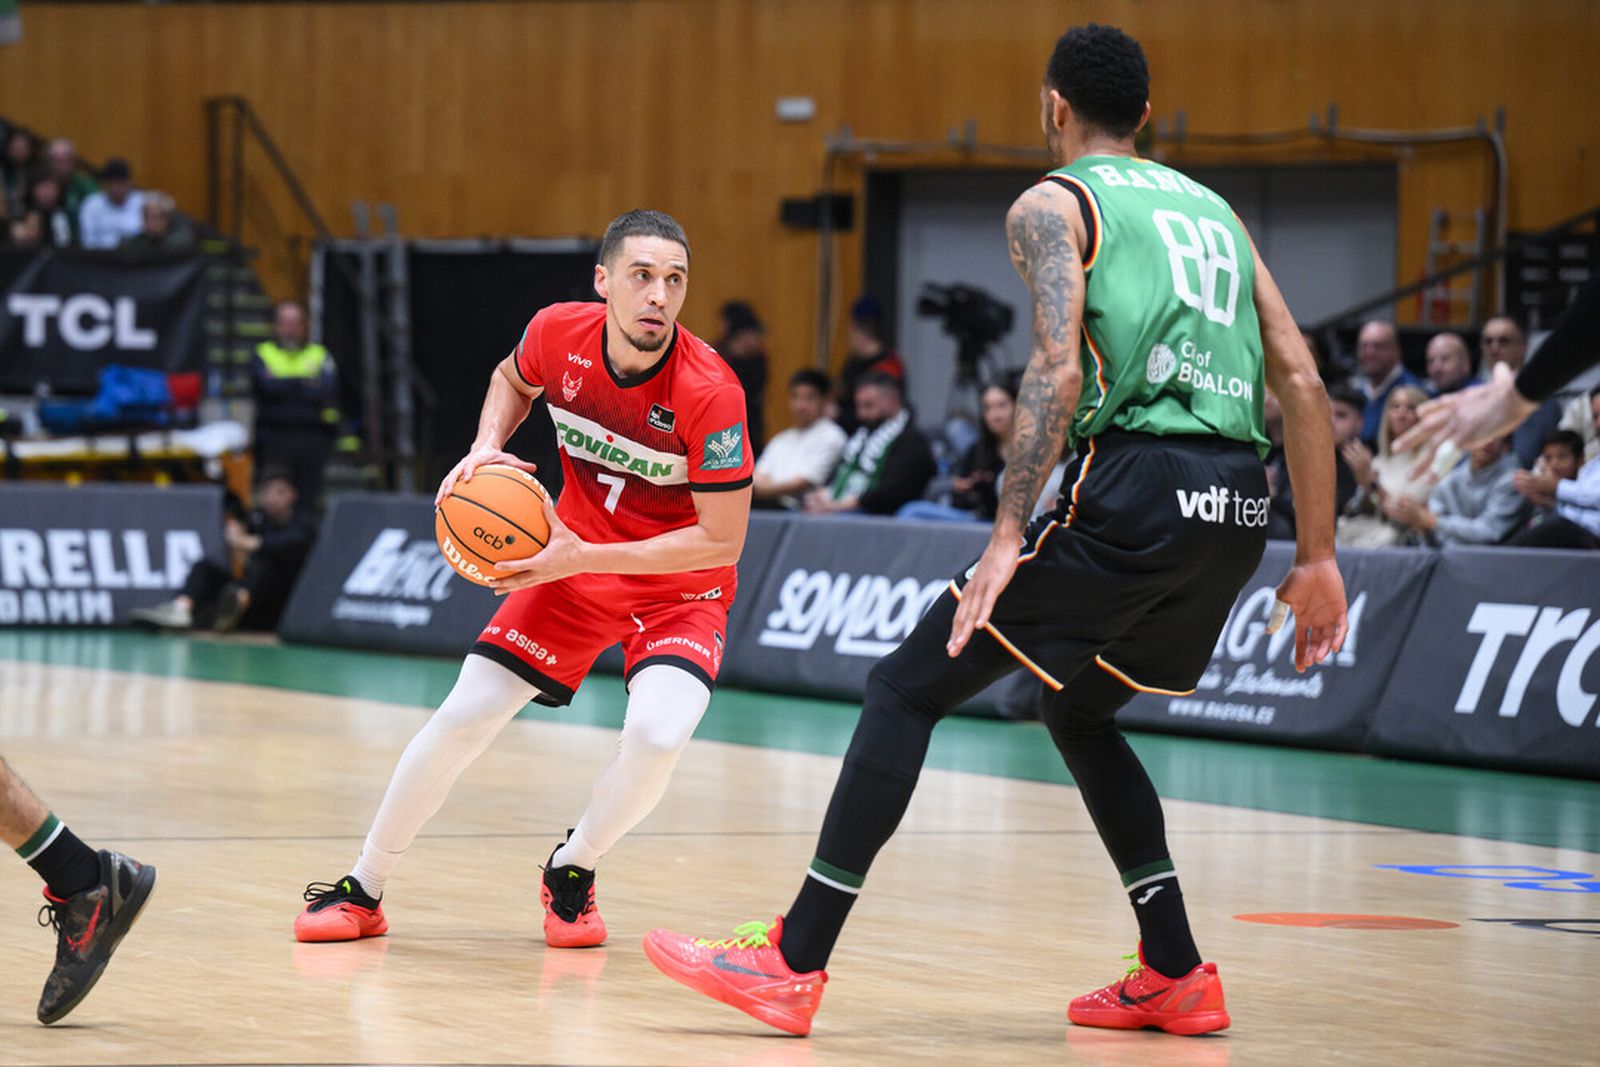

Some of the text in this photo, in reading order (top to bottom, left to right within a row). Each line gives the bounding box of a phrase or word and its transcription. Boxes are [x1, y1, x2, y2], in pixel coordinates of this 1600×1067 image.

[1152, 208, 1240, 327] 88
[8, 293, 157, 351] TCL
[567, 352, 593, 369] vive
[1197, 351, 1212, 368] of
[1177, 362, 1253, 402] BDALON
[597, 473, 626, 515] 7
[1176, 485, 1229, 523] vdf
[473, 526, 504, 550] acb
[0, 589, 113, 634] DAMM
[505, 628, 548, 660] asisa
